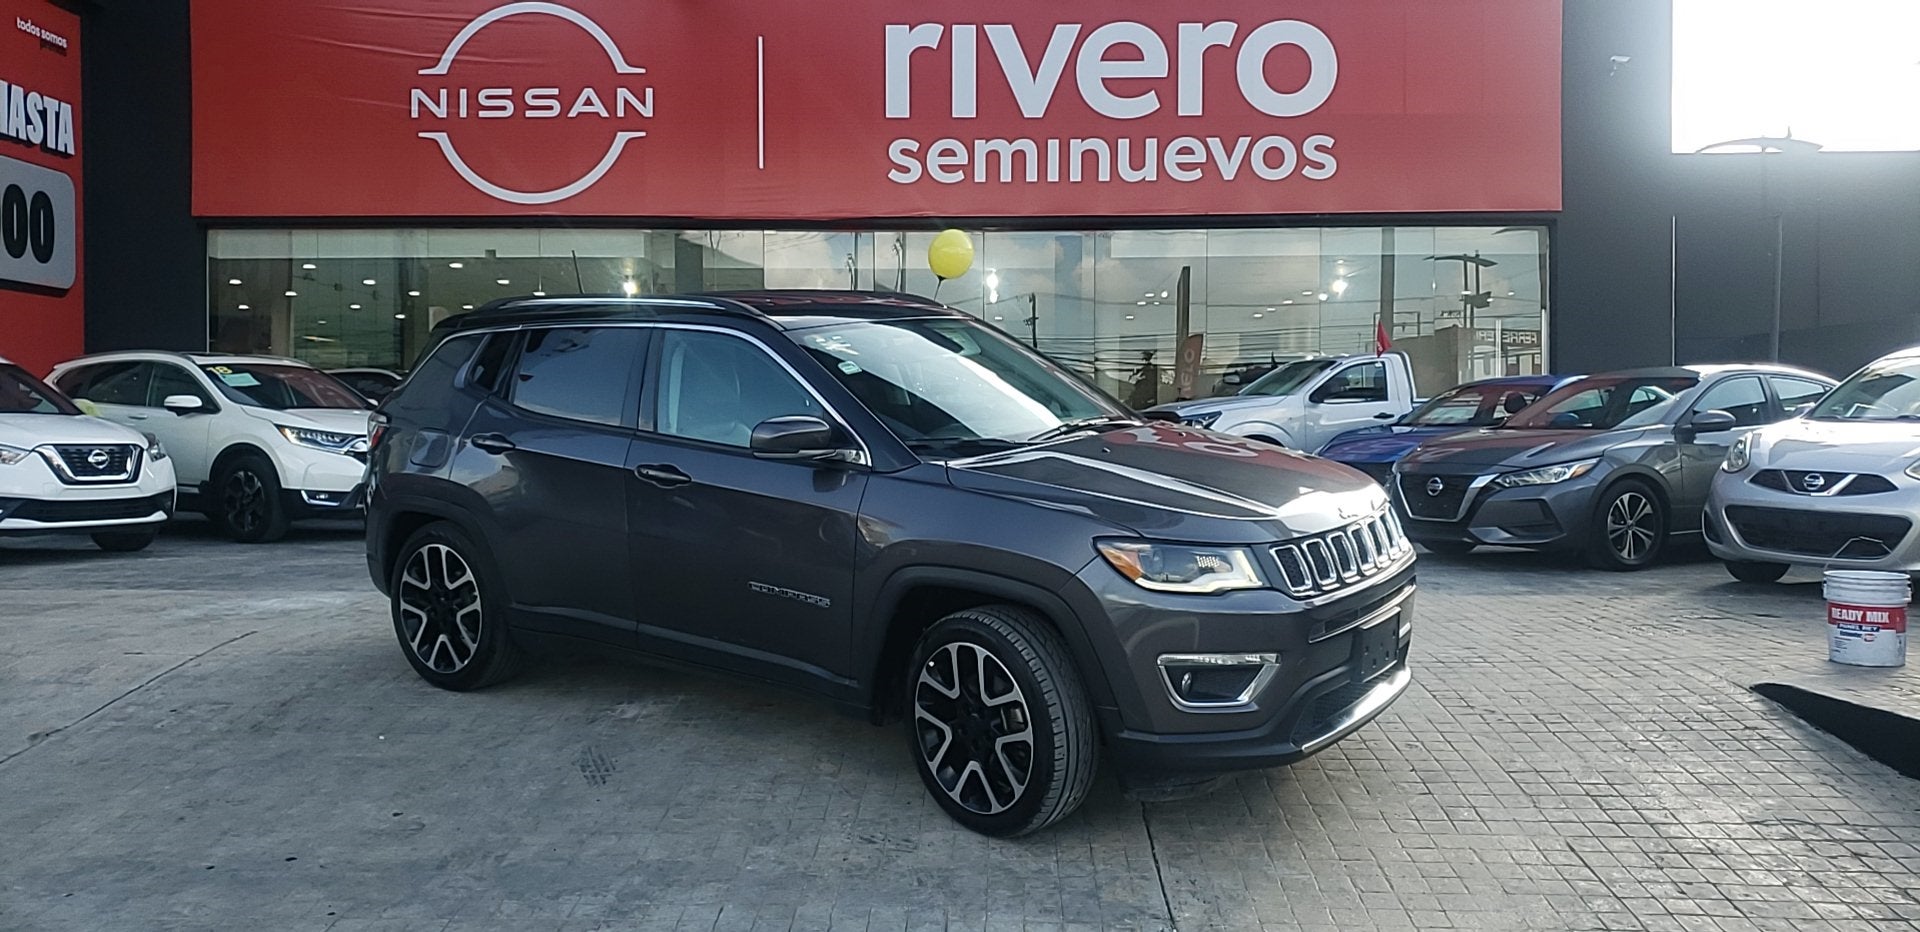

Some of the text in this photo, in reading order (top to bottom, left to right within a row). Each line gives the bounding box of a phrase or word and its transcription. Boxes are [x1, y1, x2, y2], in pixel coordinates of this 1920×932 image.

[16, 16, 68, 48] todos somos
[885, 19, 1339, 119] rivero
[410, 87, 655, 119] NISSAN
[887, 134, 1338, 184] seminuevos
[747, 581, 831, 608] COMPASS
[1831, 607, 1890, 624] READY MIX
